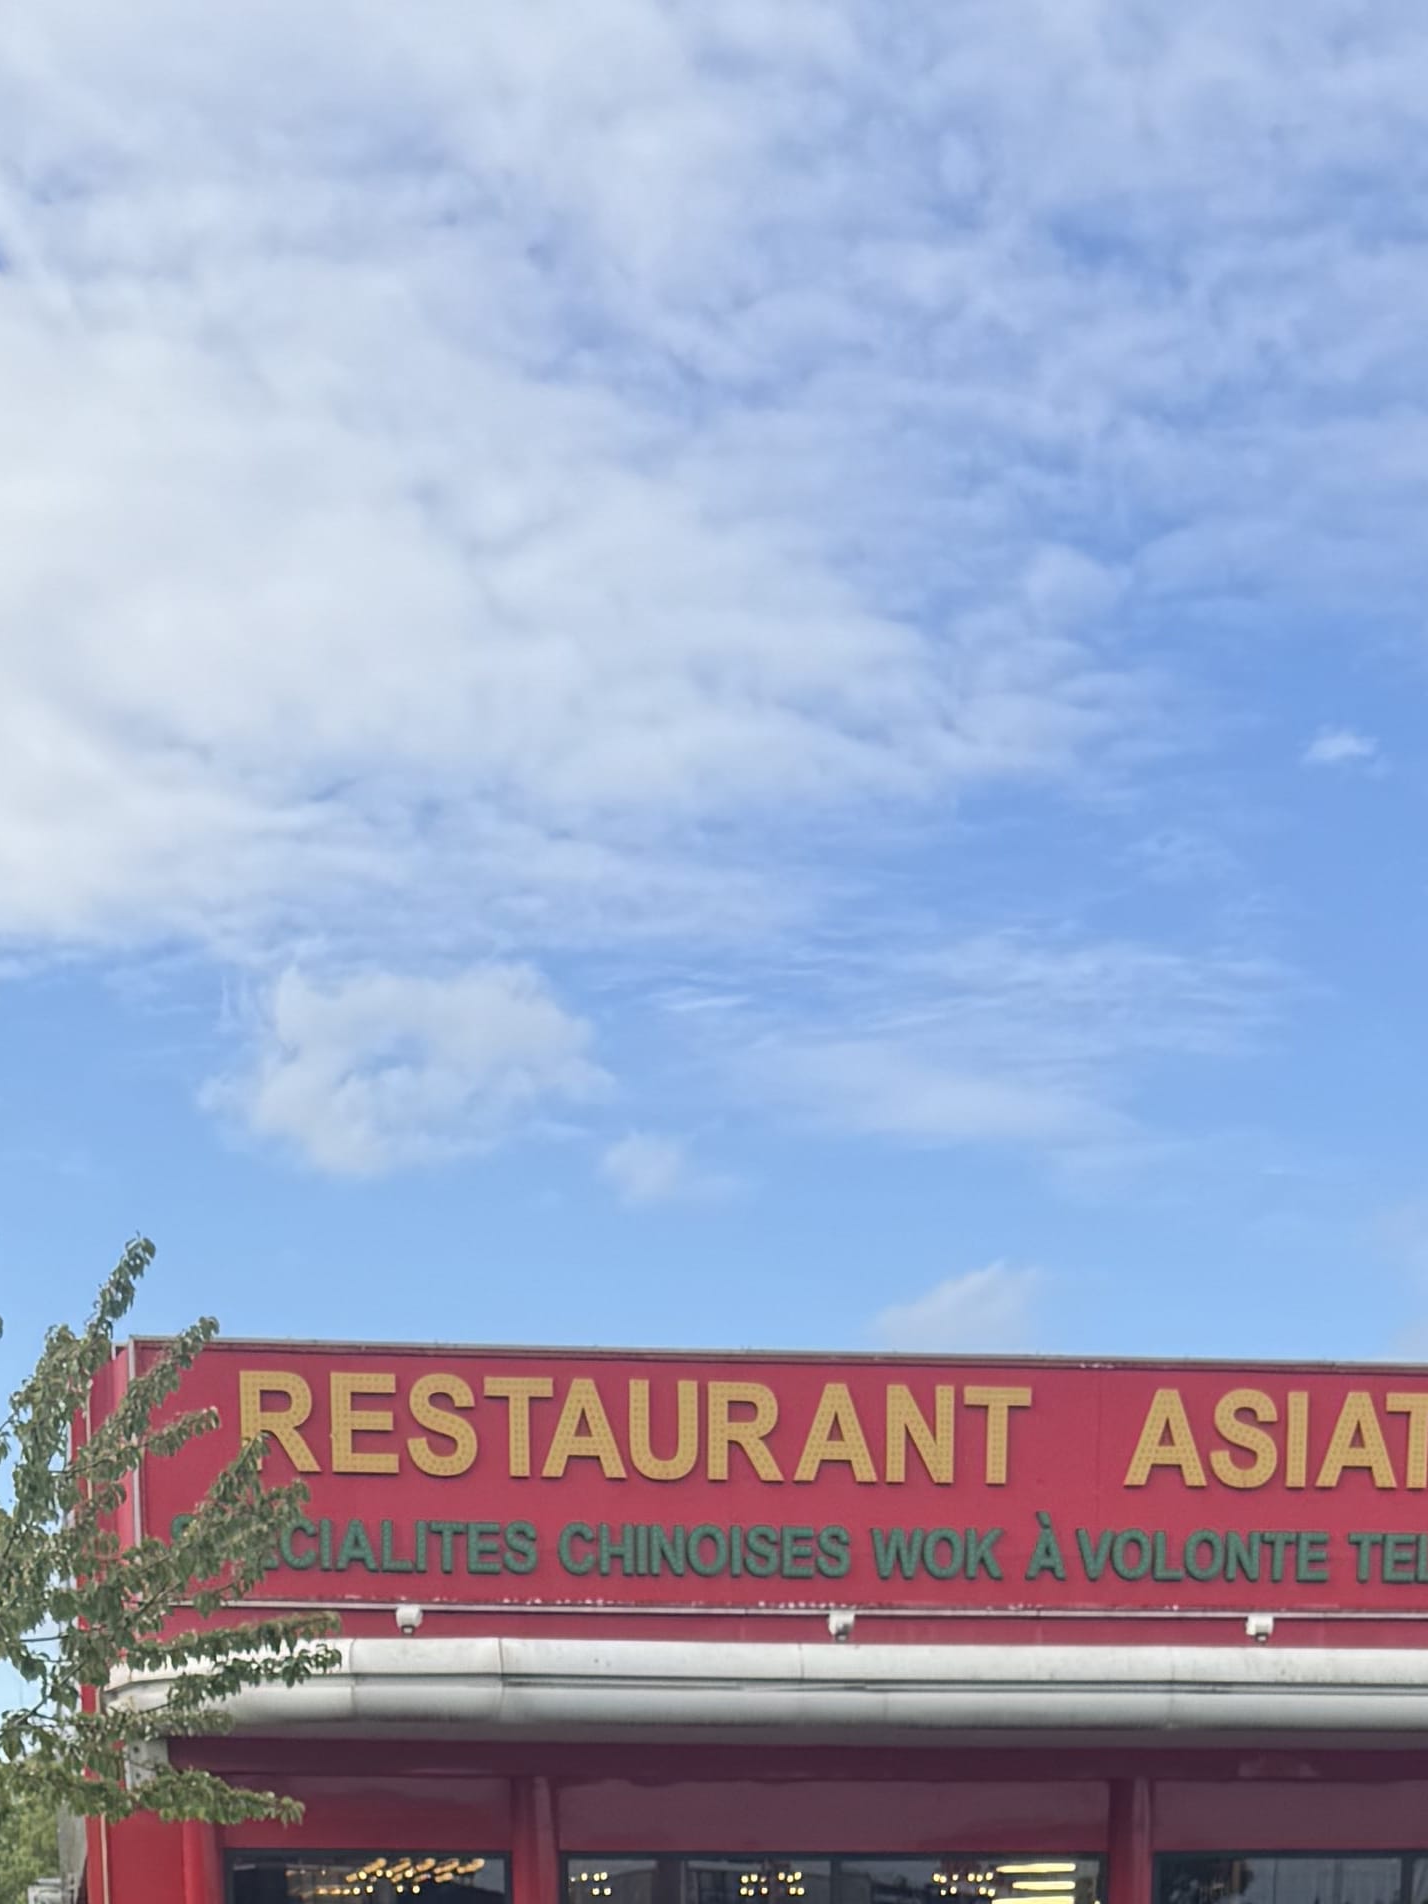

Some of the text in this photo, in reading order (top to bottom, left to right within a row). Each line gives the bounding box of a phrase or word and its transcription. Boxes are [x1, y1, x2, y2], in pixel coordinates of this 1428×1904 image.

[238, 1369, 1032, 1486] RESTAURANT
[170, 1514, 539, 1575] CIALITES
[558, 1521, 853, 1580] CHINOISES
[871, 1527, 1004, 1581] WOK
[1025, 1512, 1068, 1582] À
[1076, 1528, 1332, 1585] VOLONTE
